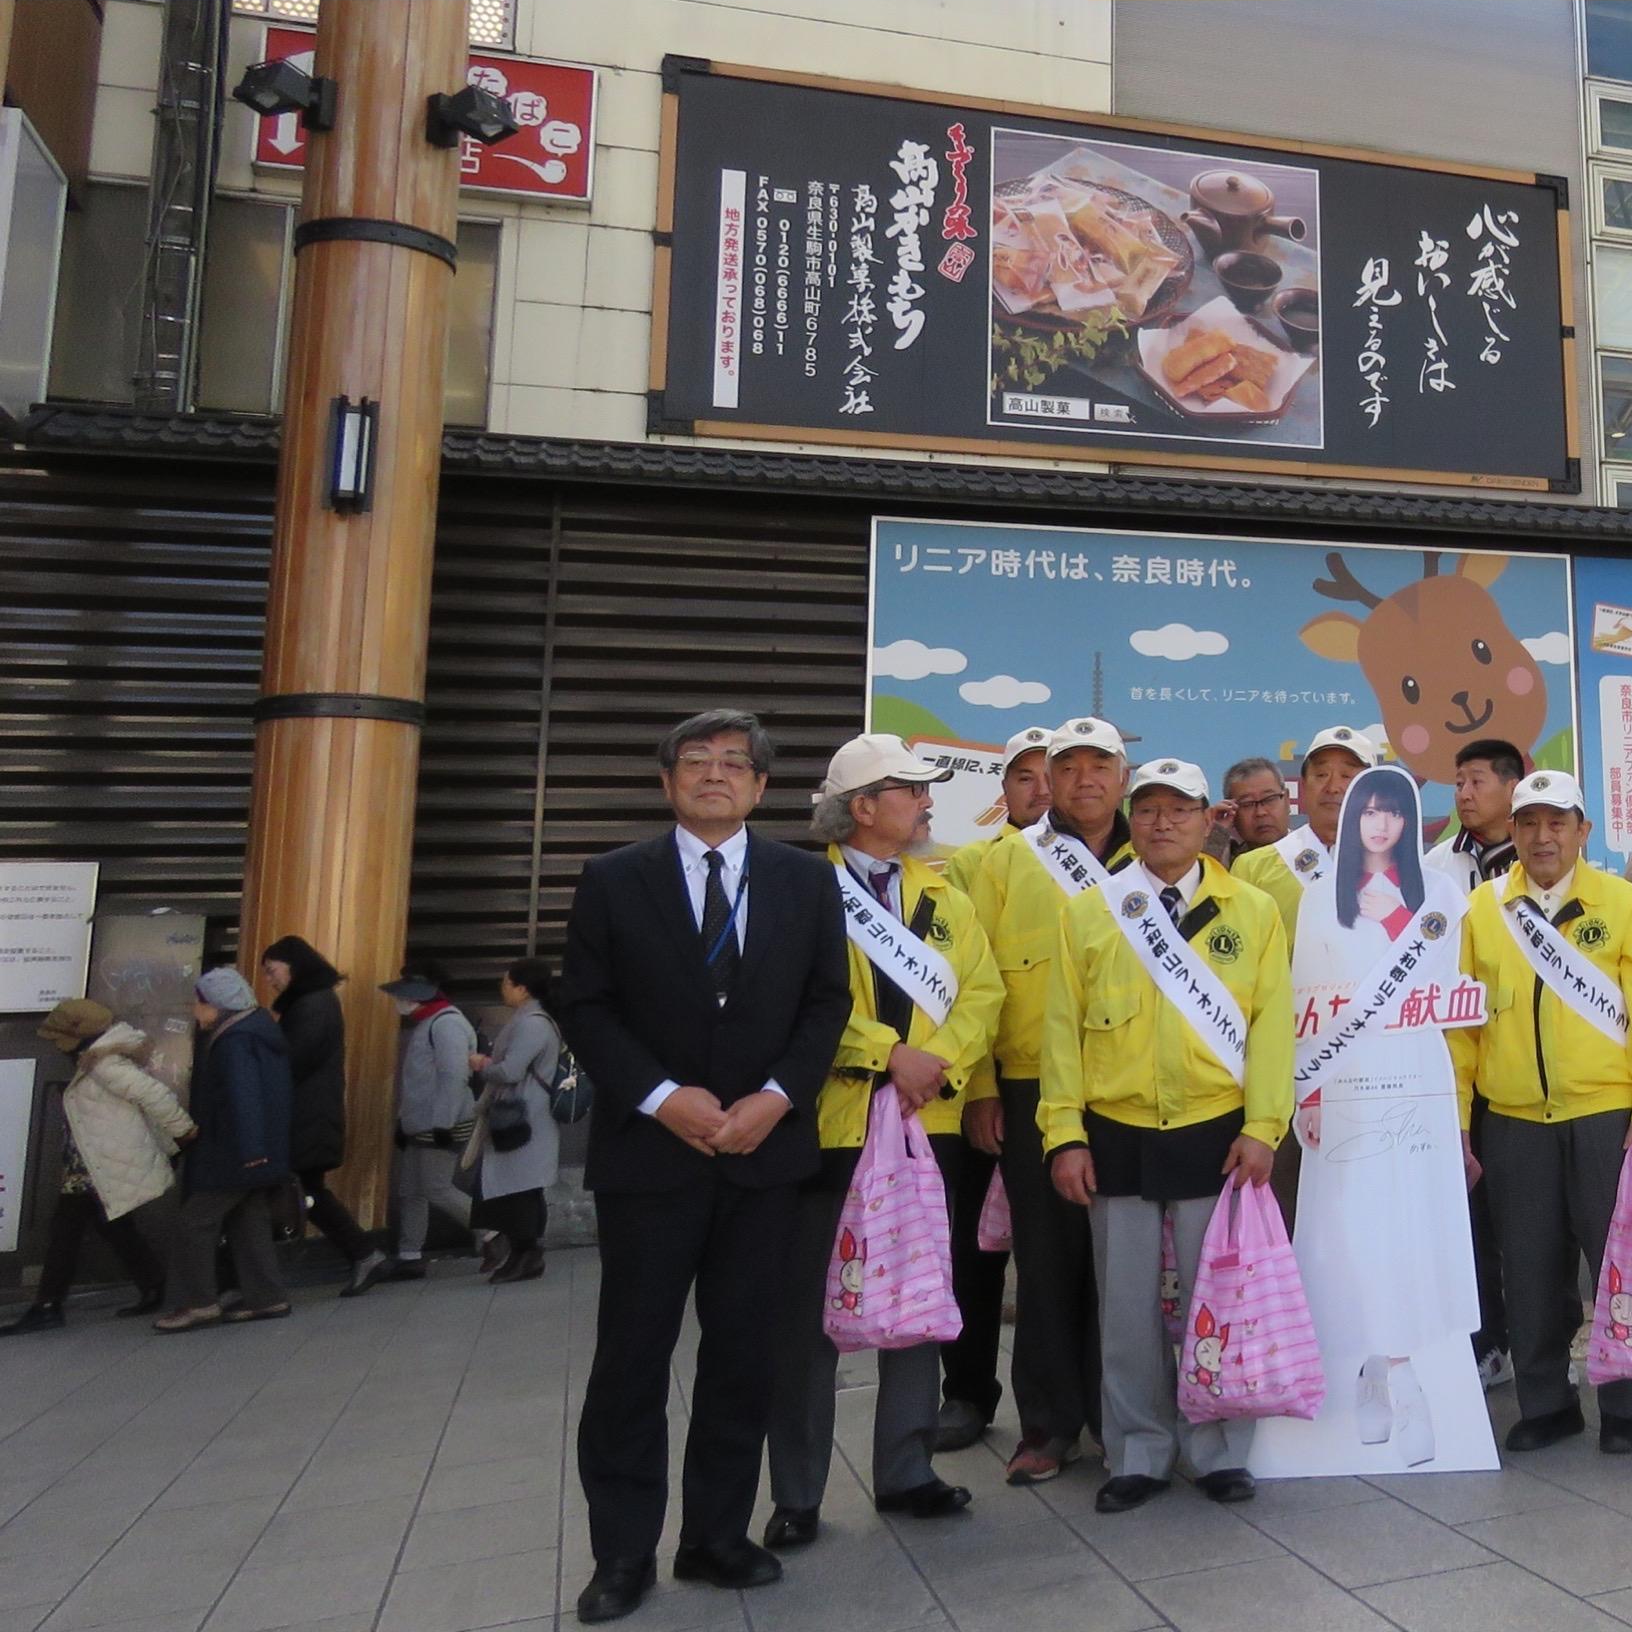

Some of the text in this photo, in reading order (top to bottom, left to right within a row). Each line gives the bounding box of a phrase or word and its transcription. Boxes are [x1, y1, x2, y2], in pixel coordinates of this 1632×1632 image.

[719, 207, 741, 378] 地方発送承っております。
[752, 175, 770, 356] FAX 0570(068)068
[804, 180, 825, 378] 奈良県生駒市高山町6785
[827, 183, 841, 289] 〒630-0101
[839, 183, 884, 416] 高山製菓株式会社
[1414, 229, 1457, 396] おいしさは
[1464, 202, 1522, 367] 心が感じる
[1007, 395, 1074, 418] 高山製菓
[1351, 255, 1404, 430] 見えるのです
[894, 542, 1255, 590] リニア時代は、奈良時代。
[1129, 686, 1360, 706] 首を長くして、リニアを待っています。
[1397, 979, 1483, 1030] 献血
